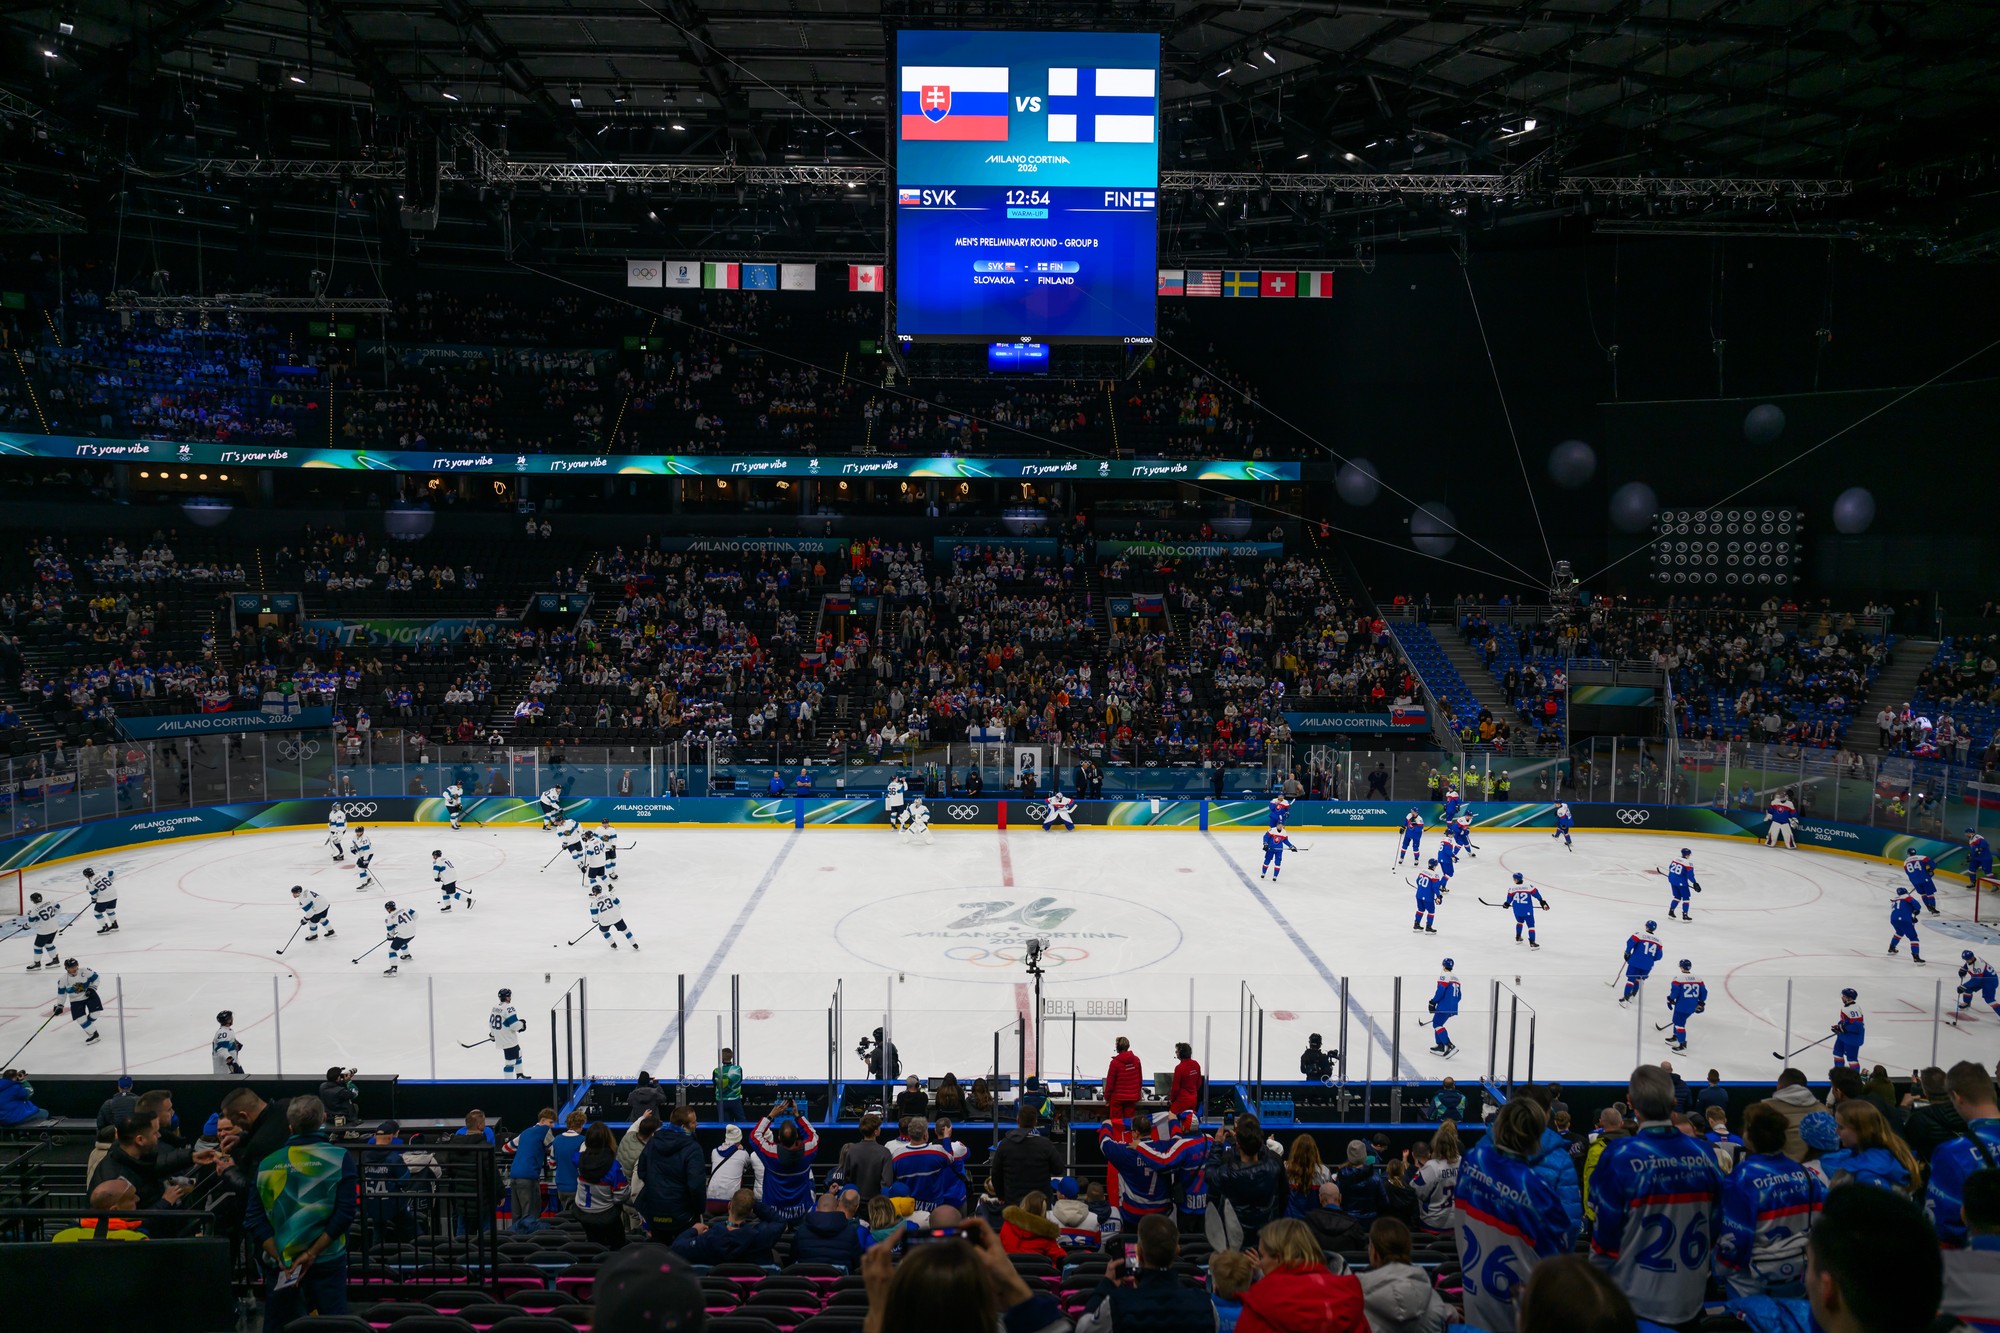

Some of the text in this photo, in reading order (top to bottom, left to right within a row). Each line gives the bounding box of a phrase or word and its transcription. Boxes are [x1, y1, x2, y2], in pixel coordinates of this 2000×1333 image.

[1015, 96, 1042, 112] VS
[985, 155, 1071, 164] MILANO CORTINA
[1017, 164, 1038, 172] 2026
[922, 189, 957, 206] SVK
[1006, 190, 1051, 206] 12:54
[1104, 191, 1132, 207] FIN
[1011, 210, 1044, 218] WARM-UP
[955, 237, 979, 247] MEN'S
[979, 237, 1030, 248] PRELIMINARY
[1030, 238, 1058, 248] ROUND
[1064, 238, 1092, 248] GROUP
[1093, 239, 1099, 248] B
[987, 262, 1004, 271] SVK
[1049, 262, 1063, 271] FIN
[973, 276, 1016, 284] SLOVAKIA
[1037, 276, 1075, 285] FINLAND
[97, 445, 127, 456] your
[128, 443, 150, 454] vibe
[239, 453, 267, 463] your
[267, 450, 288, 461] vibe
[450, 459, 474, 470] your
[474, 456, 493, 466] vibe
[566, 461, 590, 471] your
[590, 458, 607, 467] vibe
[747, 463, 769, 473] your
[769, 459, 787, 469] vibe
[859, 464, 881, 474] your
[881, 460, 898, 470] vibe
[1037, 465, 1060, 475] your
[1060, 462, 1078, 472] vibe
[1149, 466, 1170, 476] your
[1170, 463, 1188, 473] vibe
[686, 541, 824, 551] MILANO CORTINA 2026
[1126, 546, 1177, 556] MILANO
[1233, 547, 1258, 557] 2026
[156, 714, 293, 731] MILANO CORTINA 2026
[1300, 718, 1343, 726] MILANO
[1344, 719, 1388, 727] CORTINA
[129, 816, 203, 831] MILANO CORTINA
[157, 825, 175, 834] 2026
[1796, 825, 1860, 840] ILANO CORTINA
[1814, 833, 1832, 841] 2026
[1671, 863, 1682, 875] 28
[1906, 860, 1922, 873] 84
[95, 877, 112, 891] 56
[1418, 874, 1429, 888] 20
[1513, 892, 1528, 904] 42
[597, 898, 614, 913] 23
[39, 906, 56, 921] 62
[397, 912, 412, 925] 41
[1643, 942, 1658, 957] 14
[1683, 983, 1700, 998] 23
[1850, 1010, 1859, 1018] 91
[1630, 1154, 1678, 1173] Držme
[1753, 1172, 1790, 1189] Držme
[1635, 1211, 1709, 1272] 26
[1462, 1225, 1520, 1304] 26
